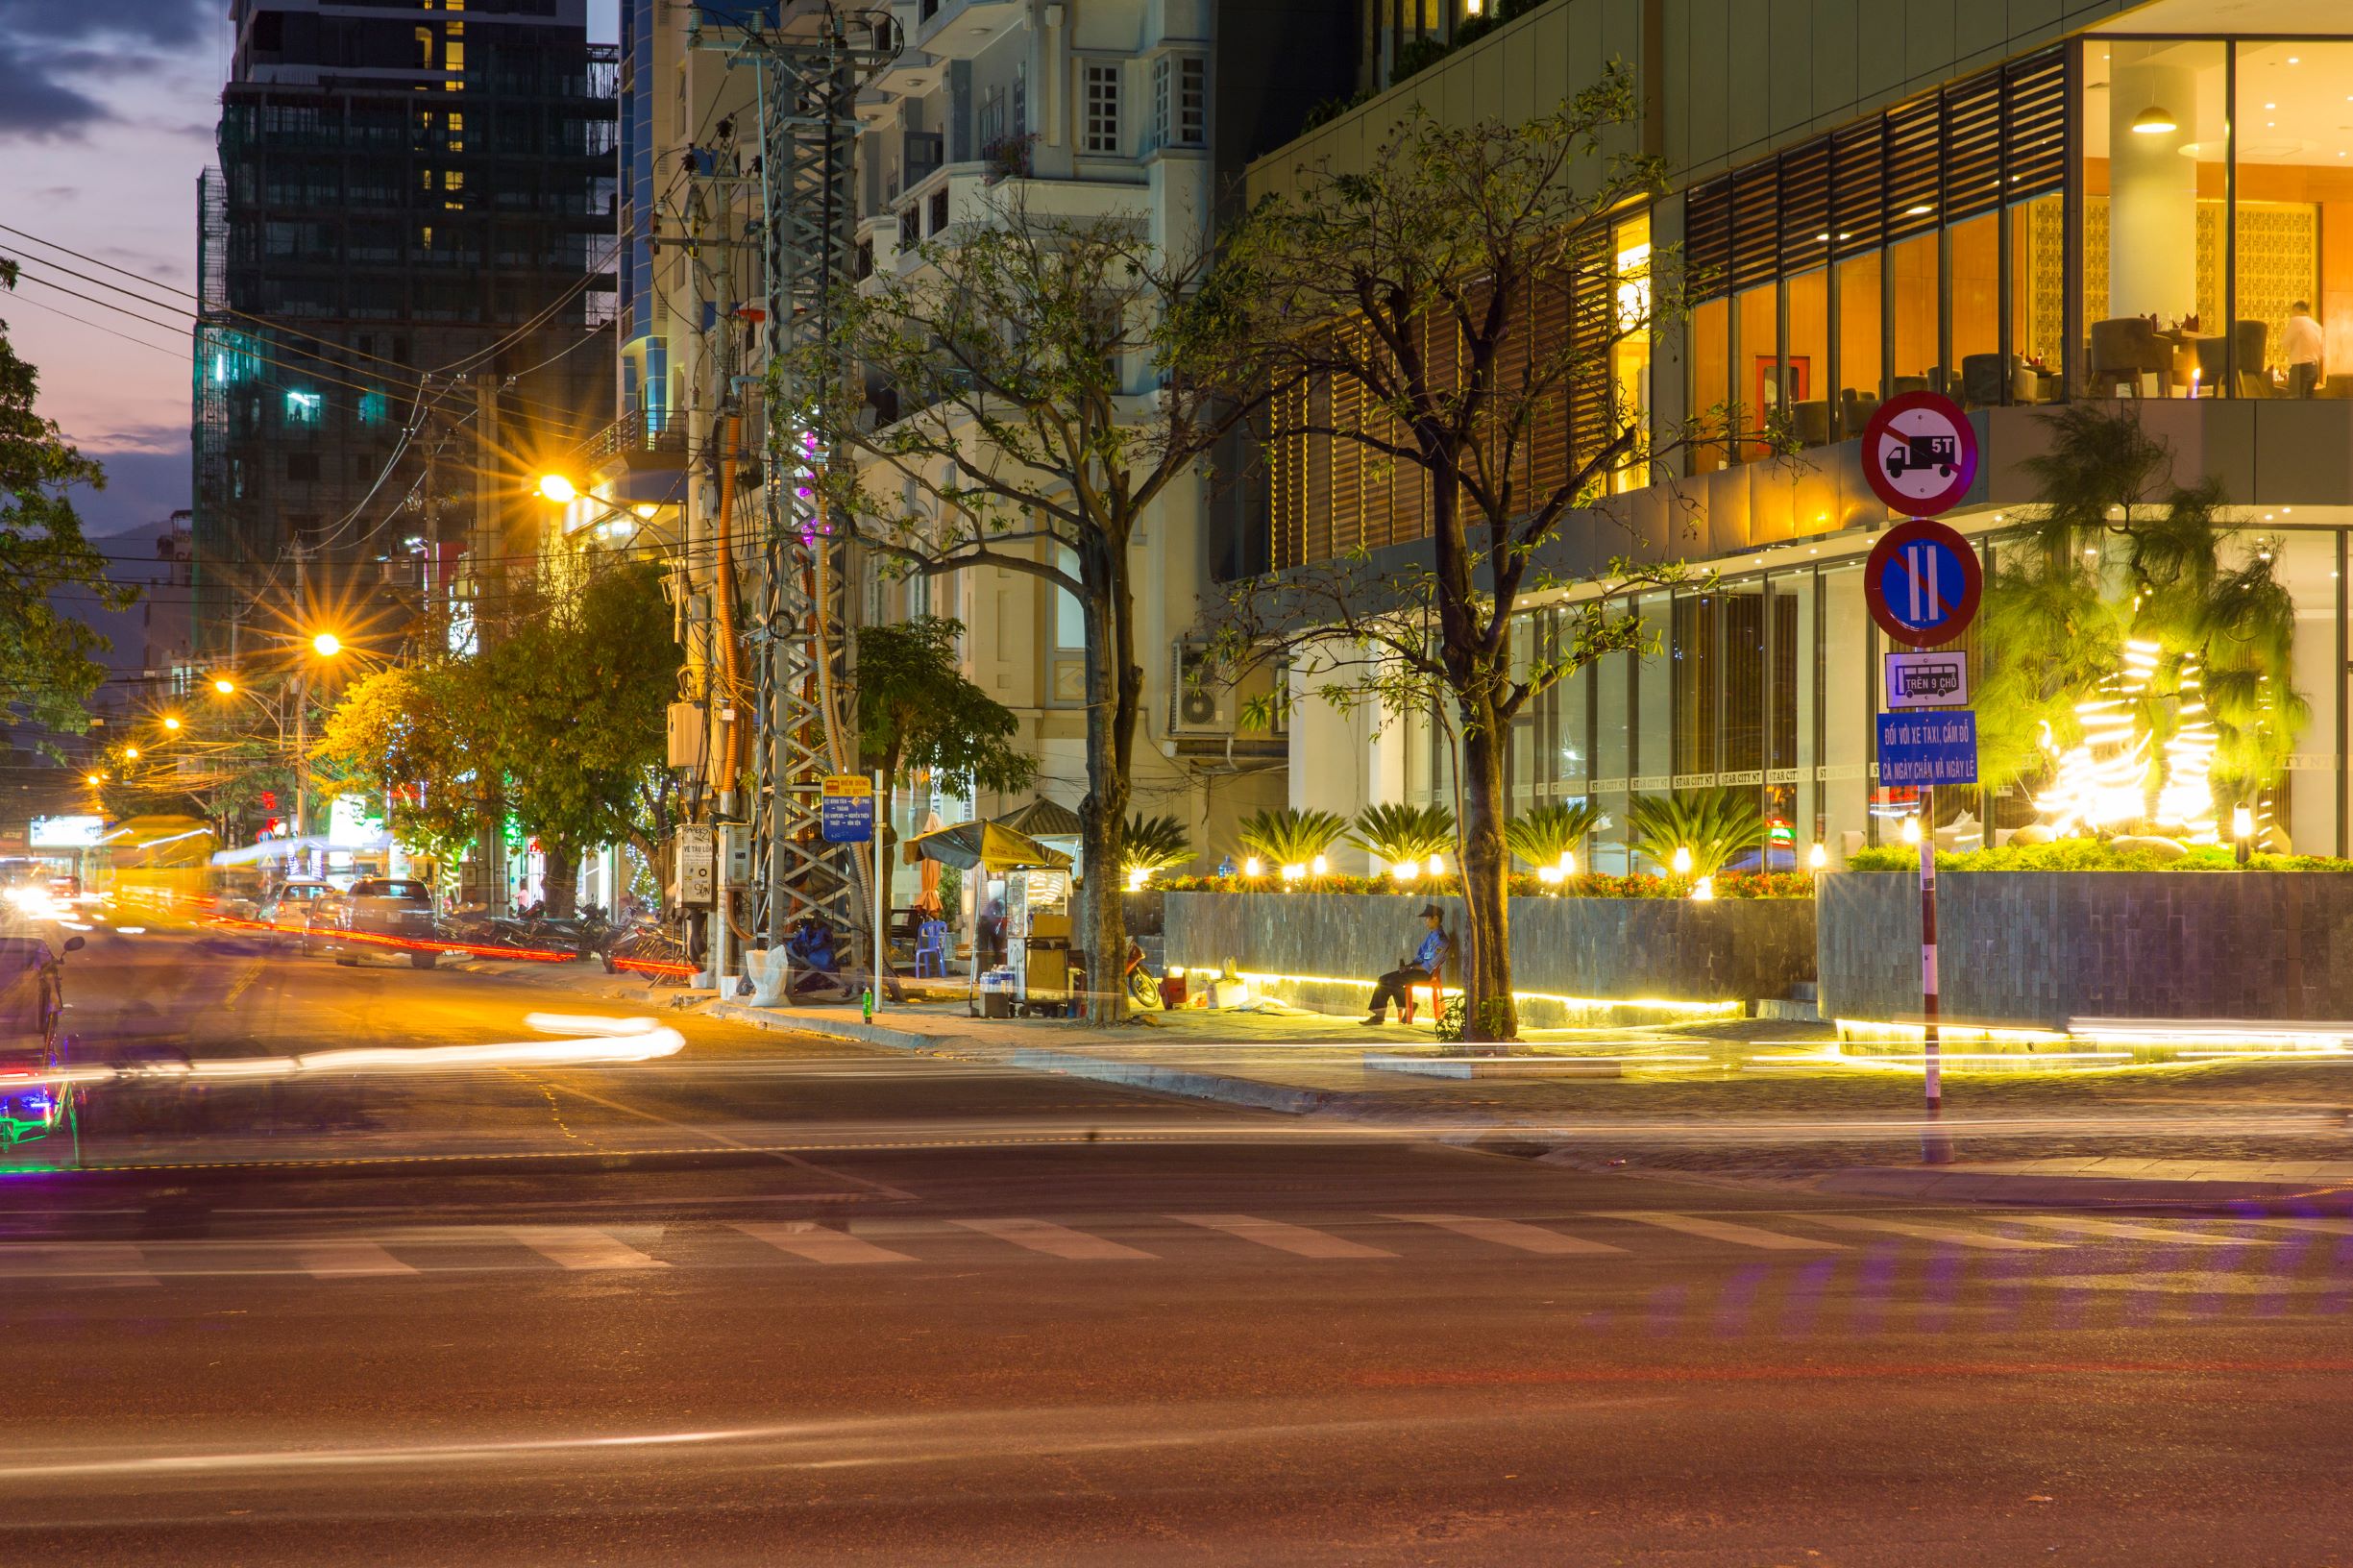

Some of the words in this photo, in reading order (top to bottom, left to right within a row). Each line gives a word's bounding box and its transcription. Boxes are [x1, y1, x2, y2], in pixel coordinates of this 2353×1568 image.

[1931, 438, 1952, 453] 5T
[1906, 675, 1929, 690] TRÊN
[1931, 678, 1937, 689] 9
[1939, 673, 1957, 688] CHỖ
[1885, 723, 1897, 746] ĐỐI
[1911, 726, 1922, 745] XE
[1943, 720, 1958, 743] CẤM
[1882, 757, 1892, 780] CẢ
[1894, 758, 1913, 780] NGÀY
[1935, 757, 1945, 778] VÀ
[1946, 757, 1965, 778] NGÀY
[1676, 777, 1690, 787] STAR
[1690, 776, 1704, 786] CITY
[1704, 775, 1713, 785] NT
[1721, 773, 1737, 784] STAR
[1737, 772, 1752, 783] CITY
[1752, 772, 1761, 783] NT
